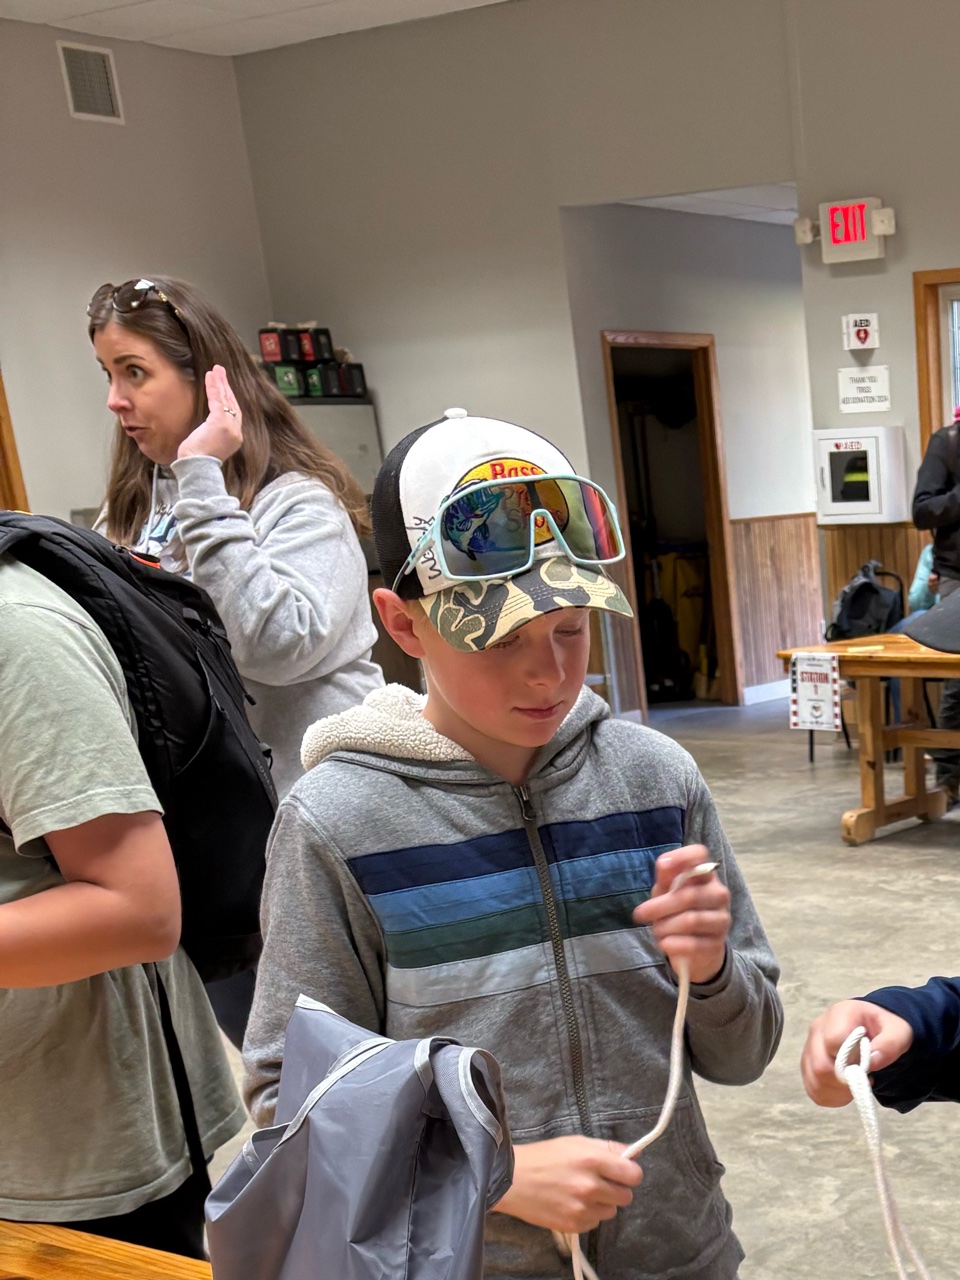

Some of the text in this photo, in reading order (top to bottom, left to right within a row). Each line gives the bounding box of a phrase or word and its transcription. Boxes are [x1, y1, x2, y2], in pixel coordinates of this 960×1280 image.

[828, 203, 867, 245] EXIT
[852, 319, 871, 328] AED
[843, 441, 862, 450] AED
[490, 462, 540, 479] Bass
[800, 671, 829, 684] STATION
